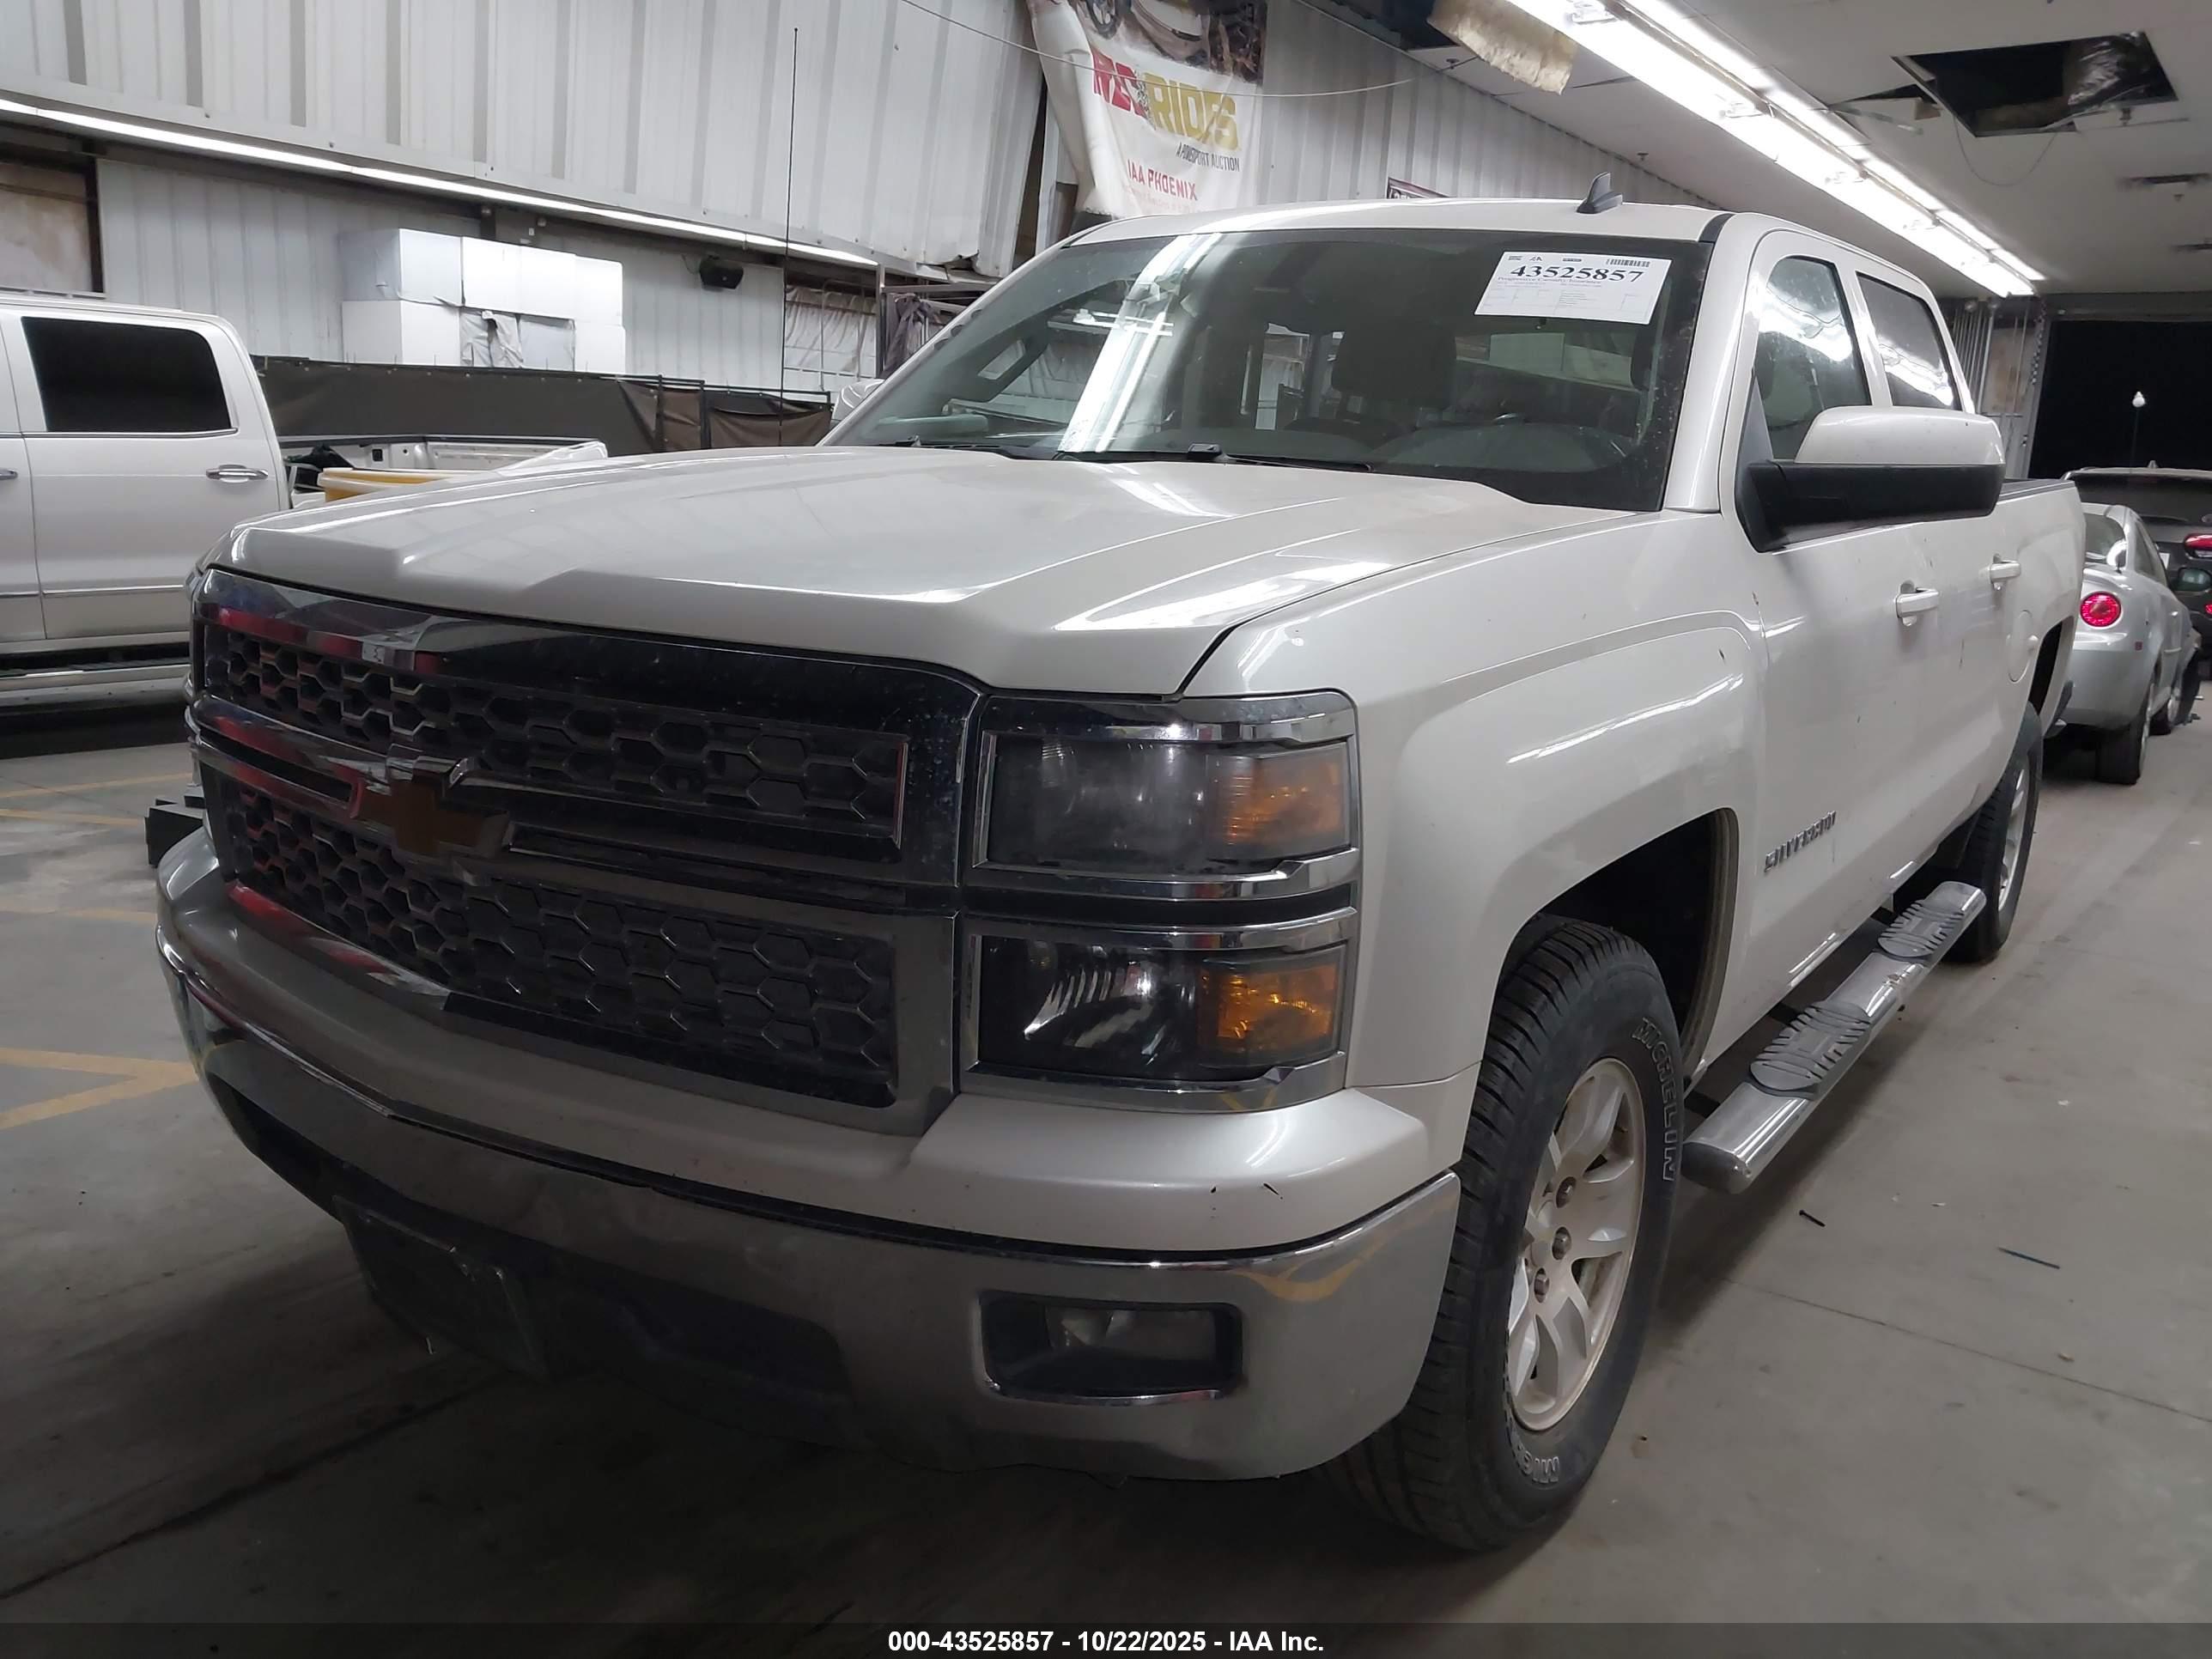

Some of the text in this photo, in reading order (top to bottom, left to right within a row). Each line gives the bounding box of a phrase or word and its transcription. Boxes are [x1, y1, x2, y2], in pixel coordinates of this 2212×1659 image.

[1211, 153, 1240, 173] AUCTION
[1127, 159, 1146, 186] IAA
[1147, 168, 1198, 201] PHOENIX
[1510, 265, 1644, 283] 43525857
[1632, 1017, 1677, 1182] MICHELIN
